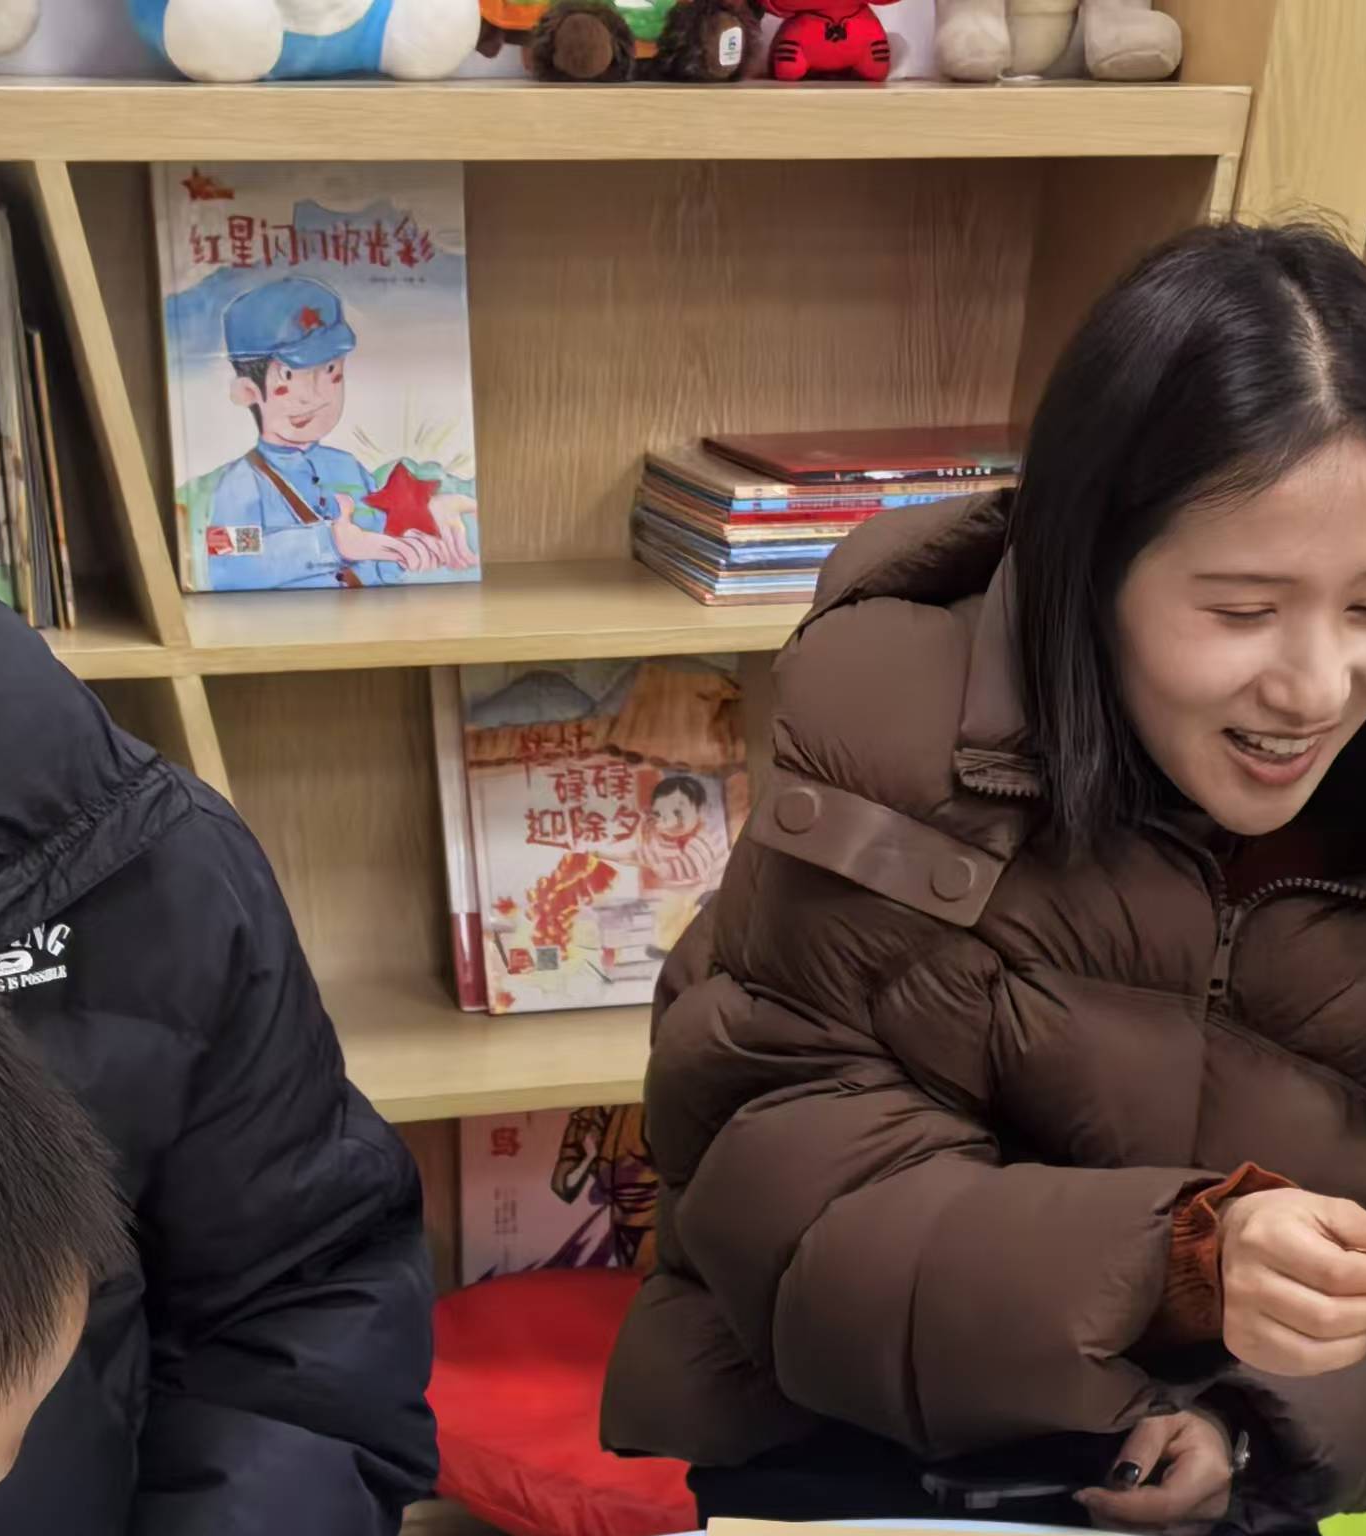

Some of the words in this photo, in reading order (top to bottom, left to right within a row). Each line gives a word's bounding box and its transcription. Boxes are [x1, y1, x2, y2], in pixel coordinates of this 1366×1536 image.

[189, 214, 436, 269] 红星闪闪放光彩
[525, 805, 641, 850] 迎除夕
